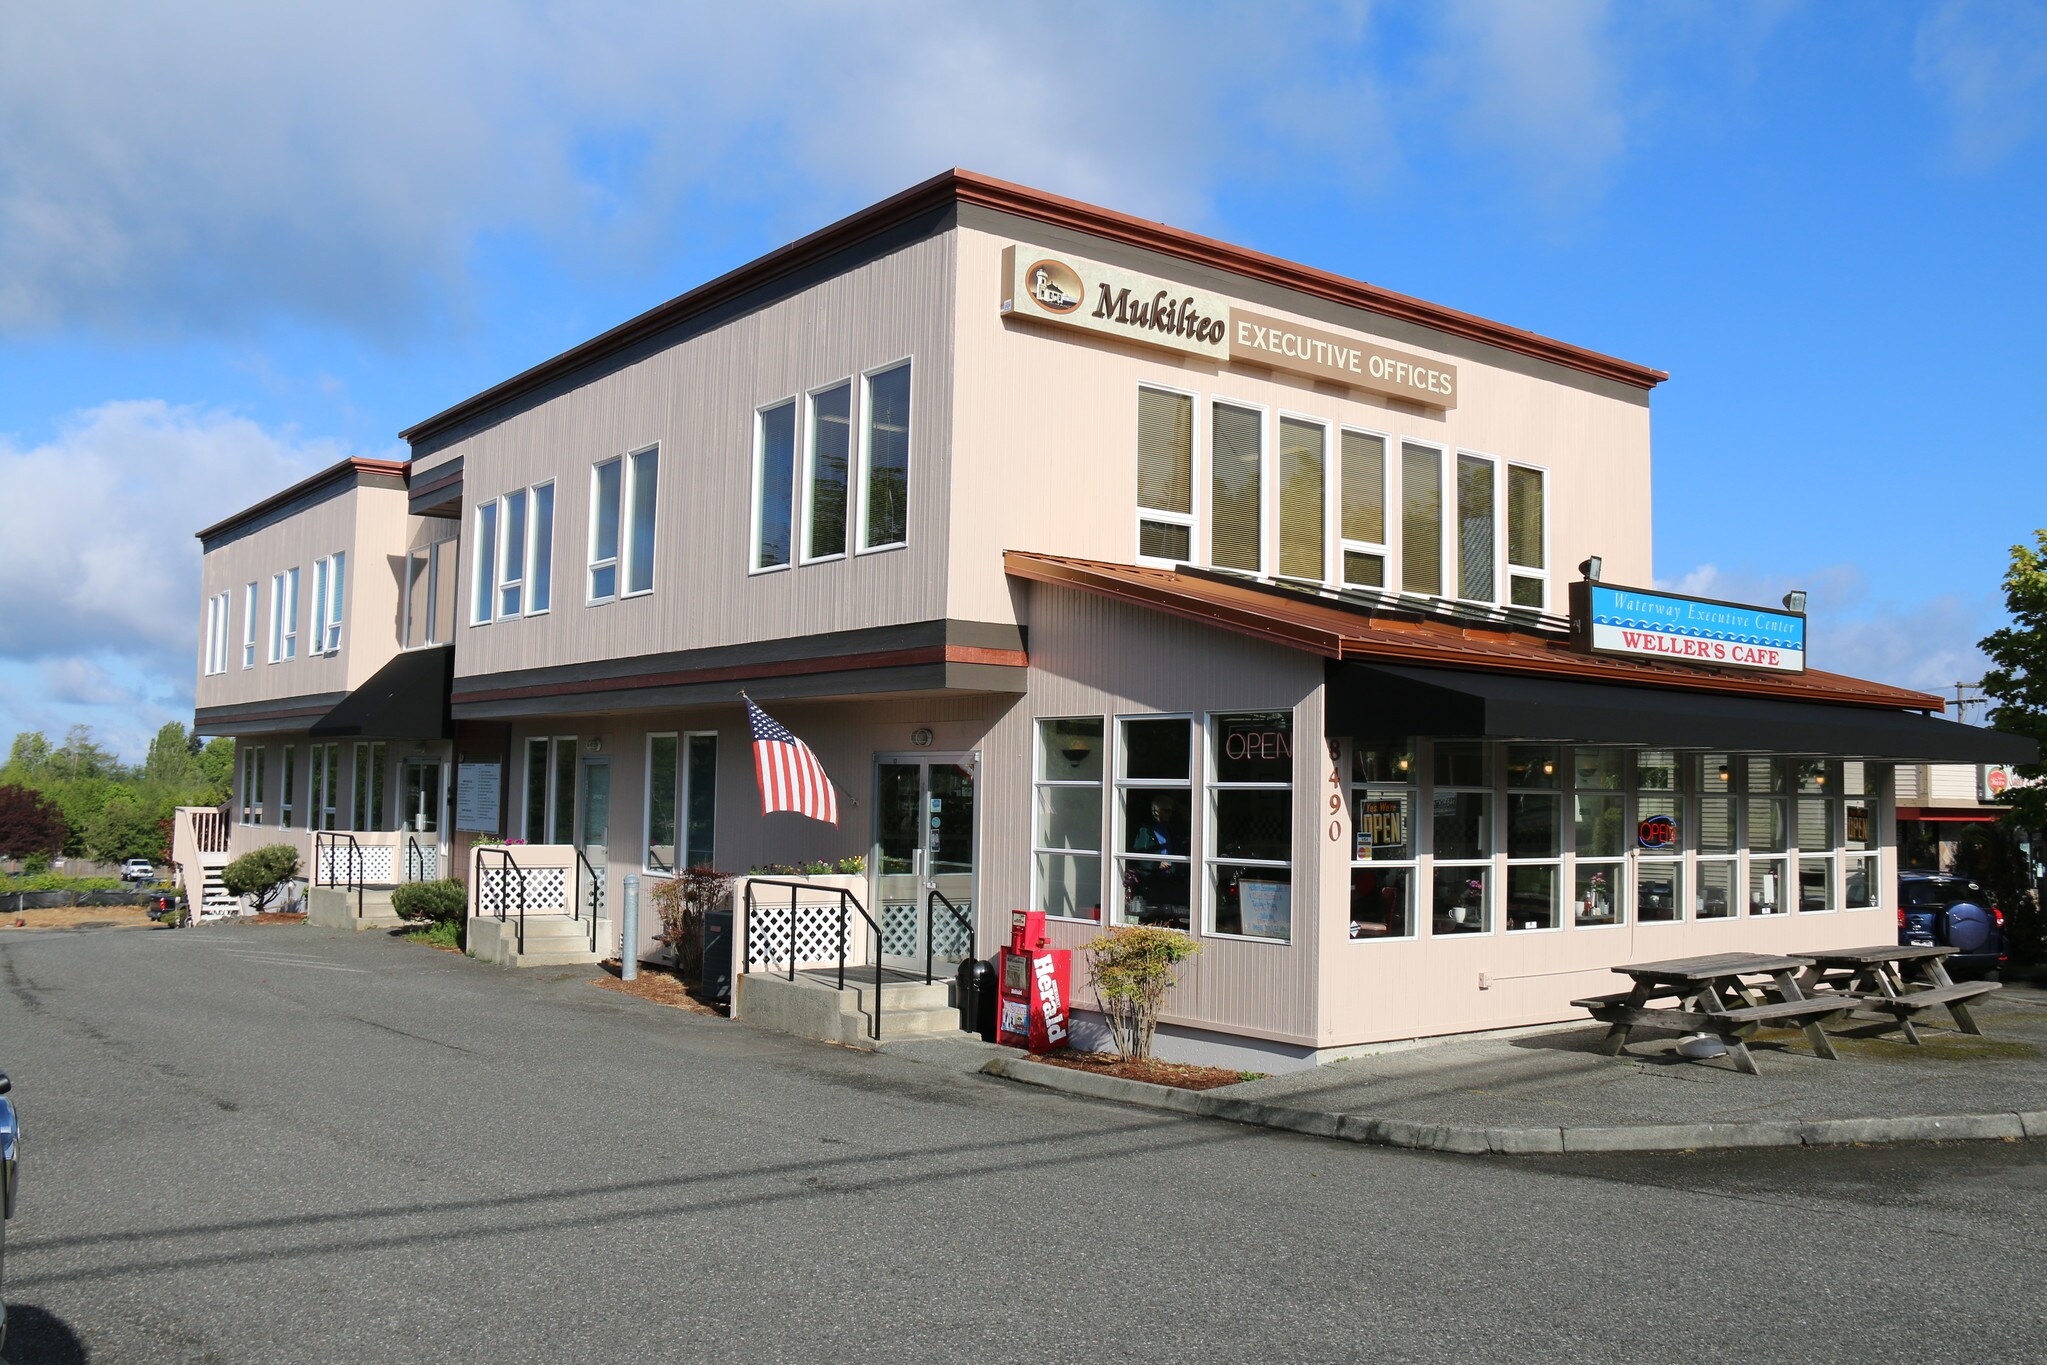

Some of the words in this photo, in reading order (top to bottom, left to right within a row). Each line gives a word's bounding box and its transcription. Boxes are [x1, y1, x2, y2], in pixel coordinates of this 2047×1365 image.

[1092, 283, 1225, 345] Mukilteo
[1237, 320, 1362, 374] EXECUTIVE
[1369, 355, 1452, 395] OFFICES
[1615, 593, 1681, 622] Waterway
[1688, 604, 1749, 627] Executive
[1755, 614, 1795, 633] Center
[1622, 631, 1726, 660] WELLER'S
[1732, 646, 1780, 666] CAFE
[1226, 733, 1293, 760] OPEN
[1329, 740, 1342, 842] 8490
[1363, 813, 1400, 844] OPEN
[1640, 823, 1676, 842] OPEN
[1848, 817, 1868, 840] OPEN
[1033, 954, 1067, 1044] Herald
